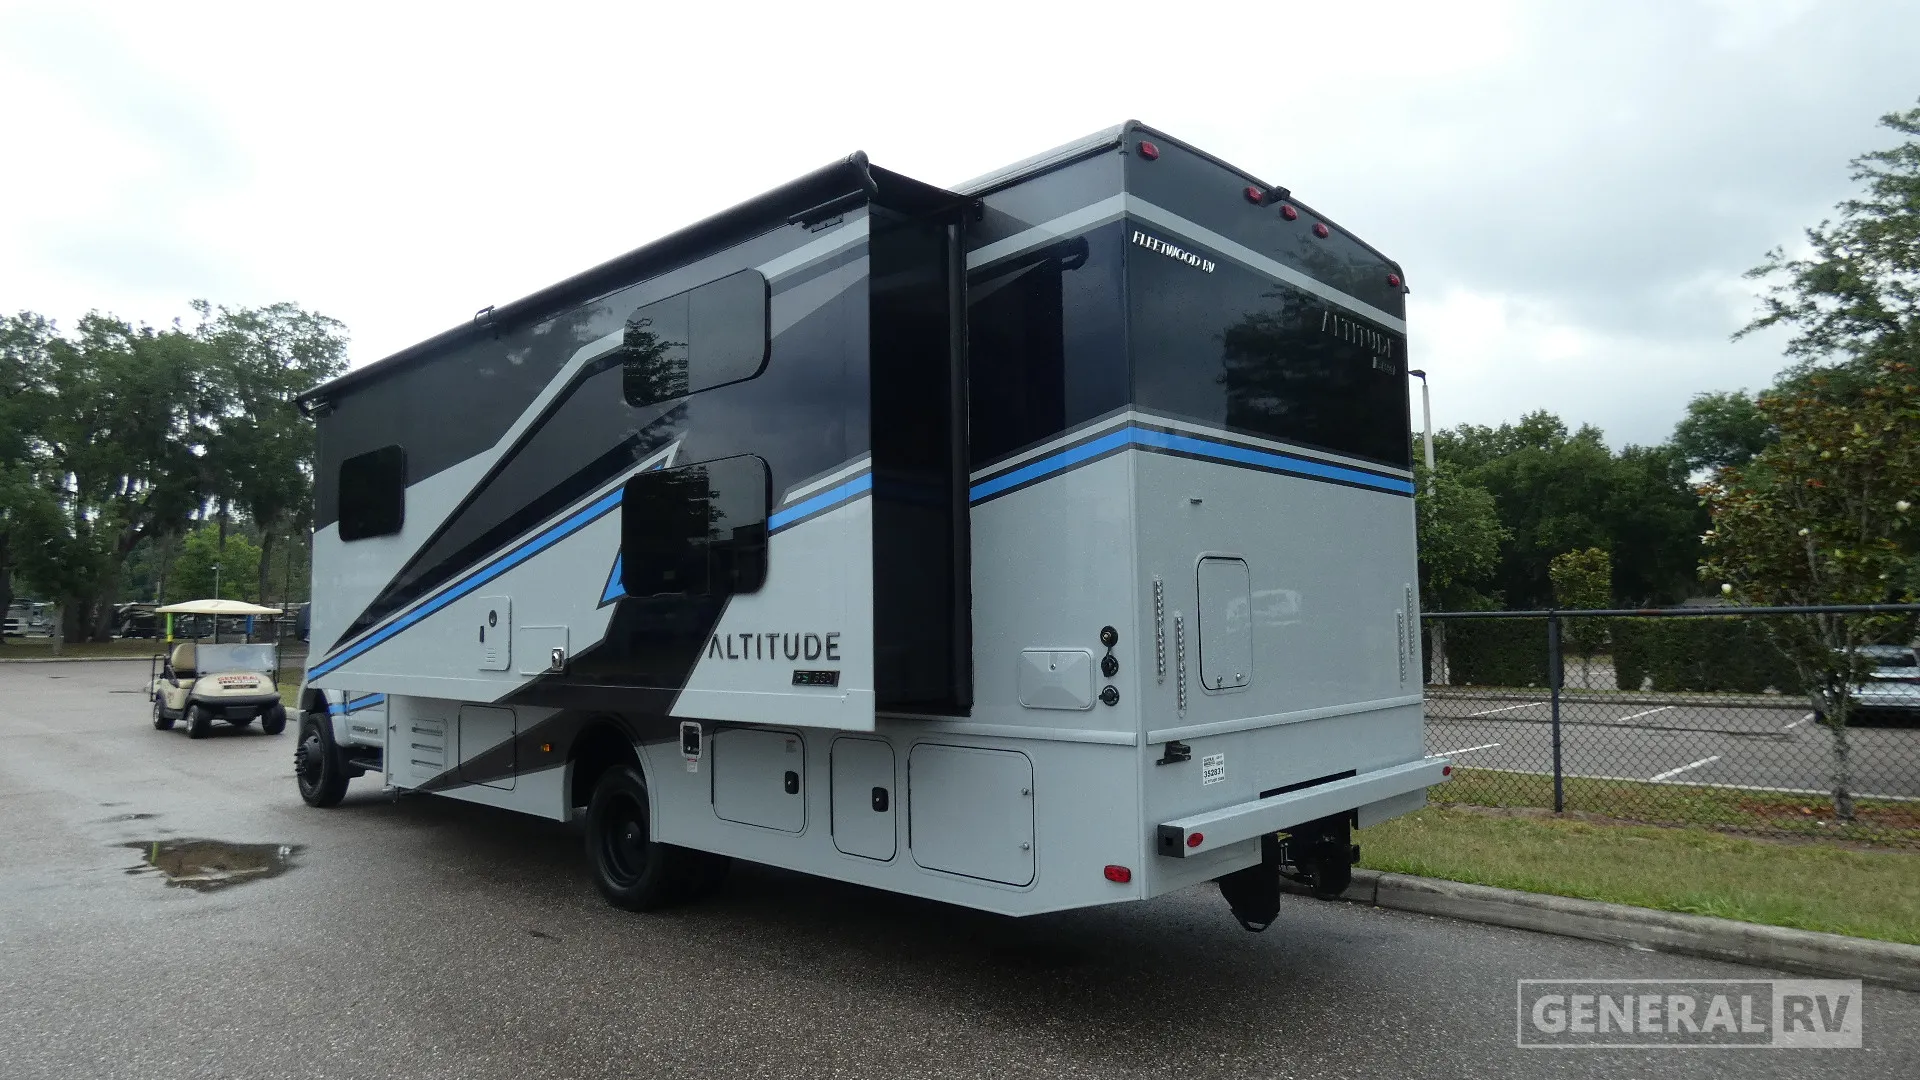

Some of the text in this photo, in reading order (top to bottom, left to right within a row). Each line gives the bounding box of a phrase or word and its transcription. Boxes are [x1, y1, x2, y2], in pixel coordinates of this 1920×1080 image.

[1132, 231, 1215, 273] FLEETWOOD RV
[1321, 311, 1392, 358] ALTITUDE
[708, 632, 840, 660] ALTITUDE
